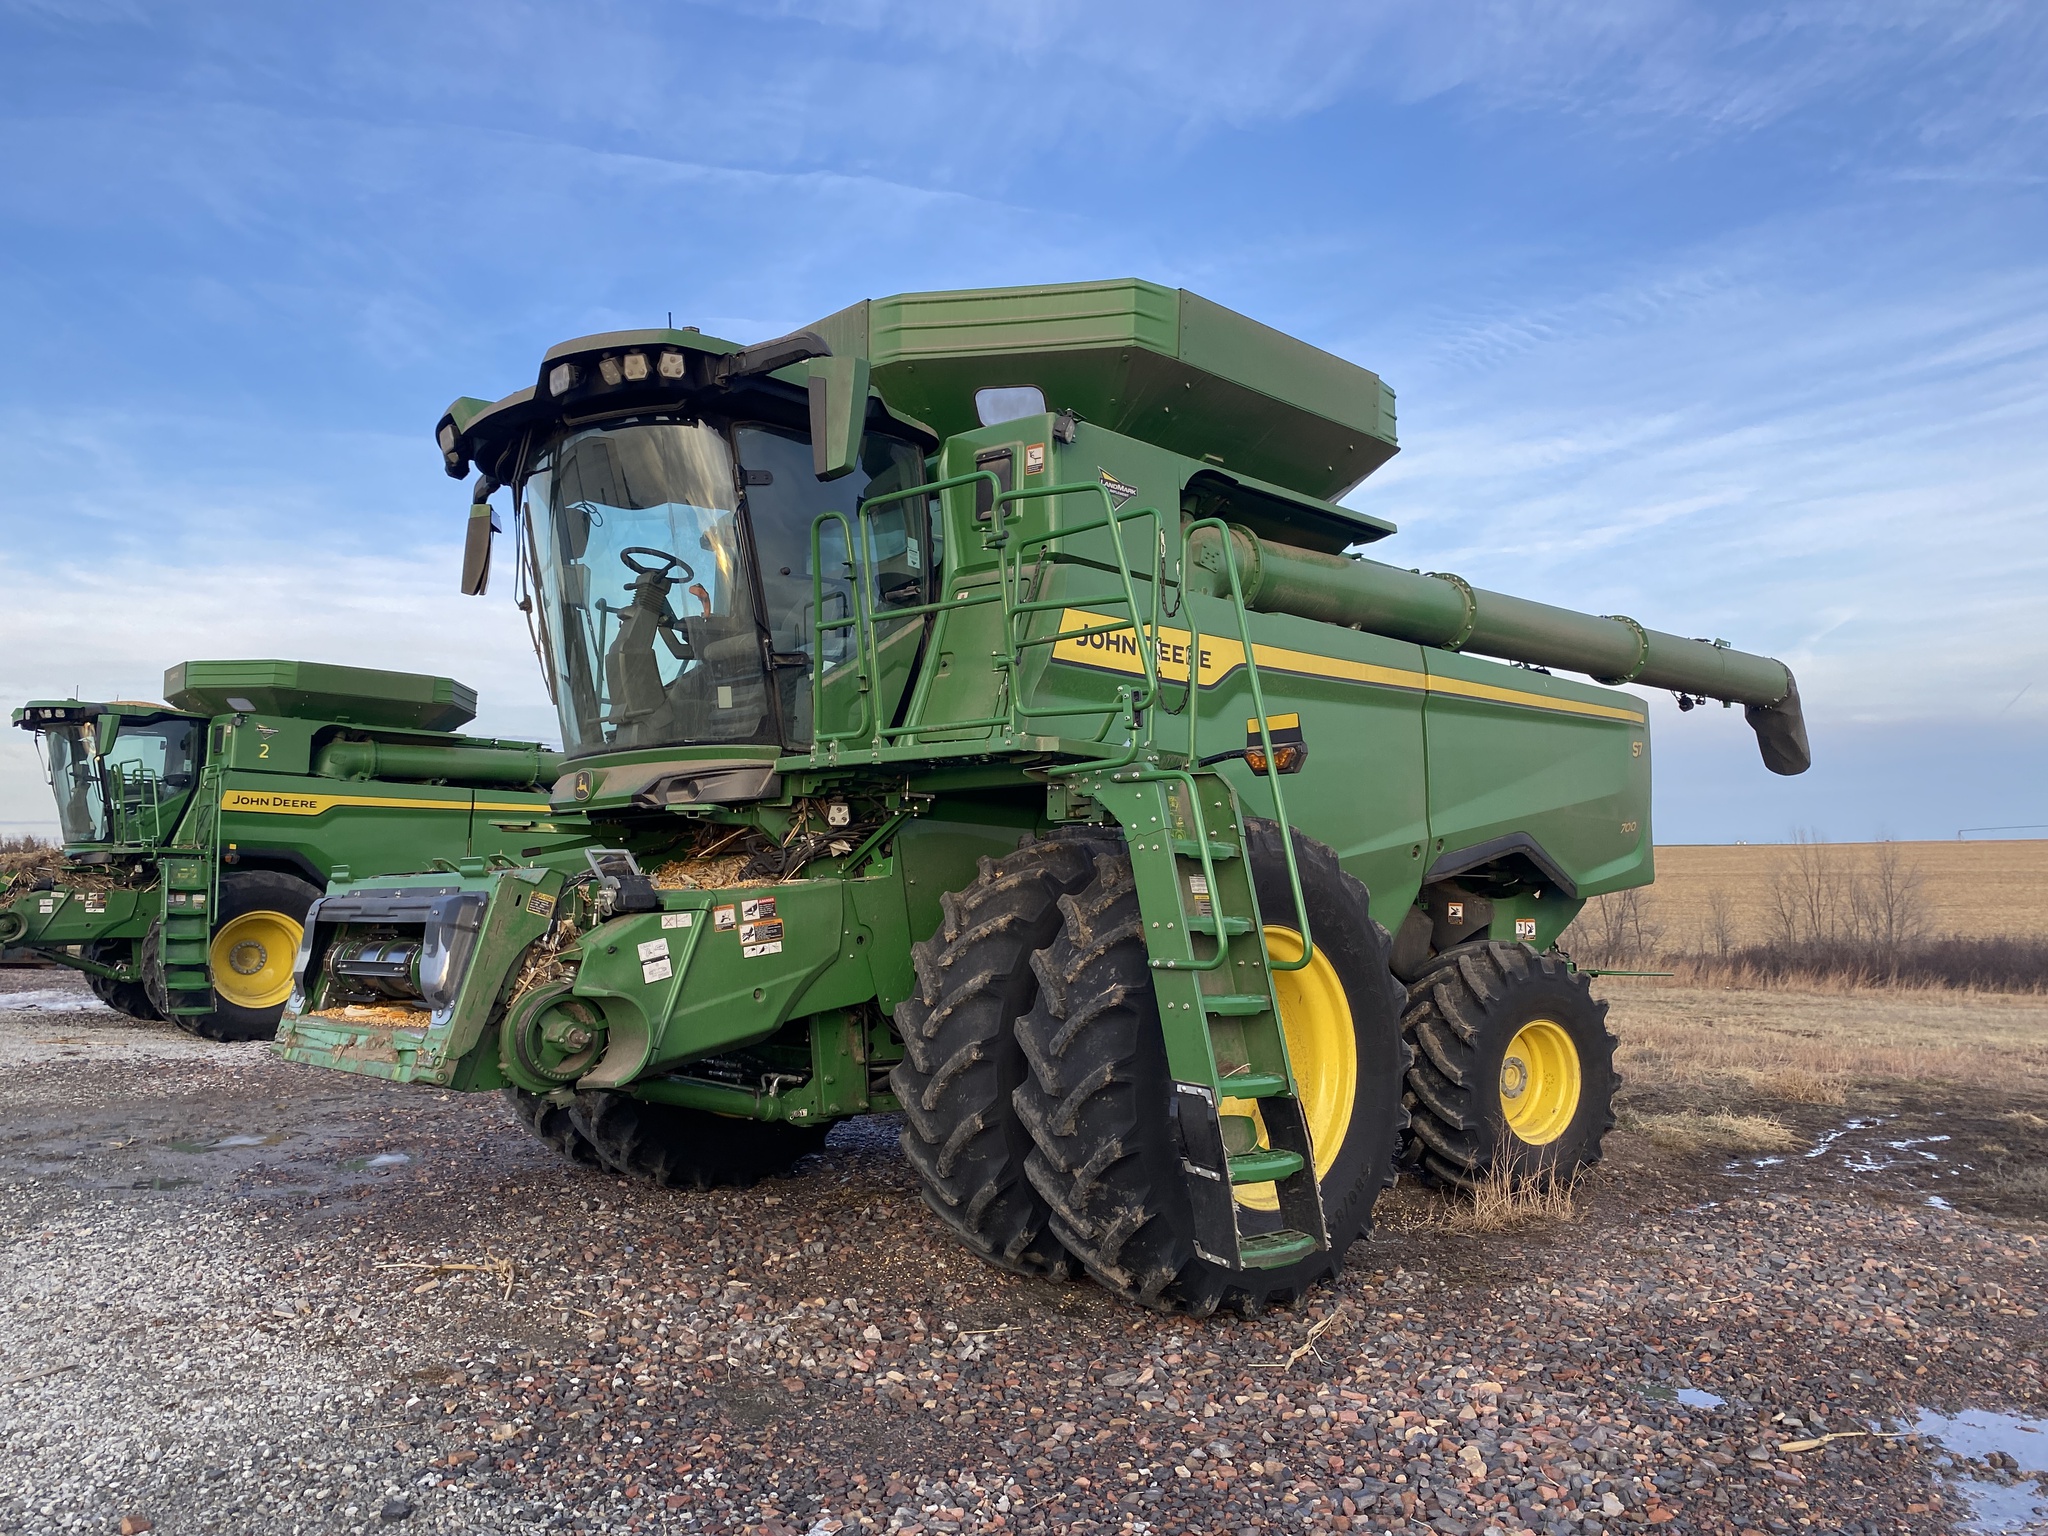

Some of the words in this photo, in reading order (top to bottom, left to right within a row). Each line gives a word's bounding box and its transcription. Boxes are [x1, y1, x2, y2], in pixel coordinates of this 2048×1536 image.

[1076, 624, 1136, 656] JOHN
[1146, 635, 1212, 669] EEE
[259, 744, 269, 758] 2
[1632, 741, 1643, 757] S7
[233, 795, 269, 806] JOHN
[273, 797, 317, 808] DEERE
[1620, 822, 1637, 833] 700
